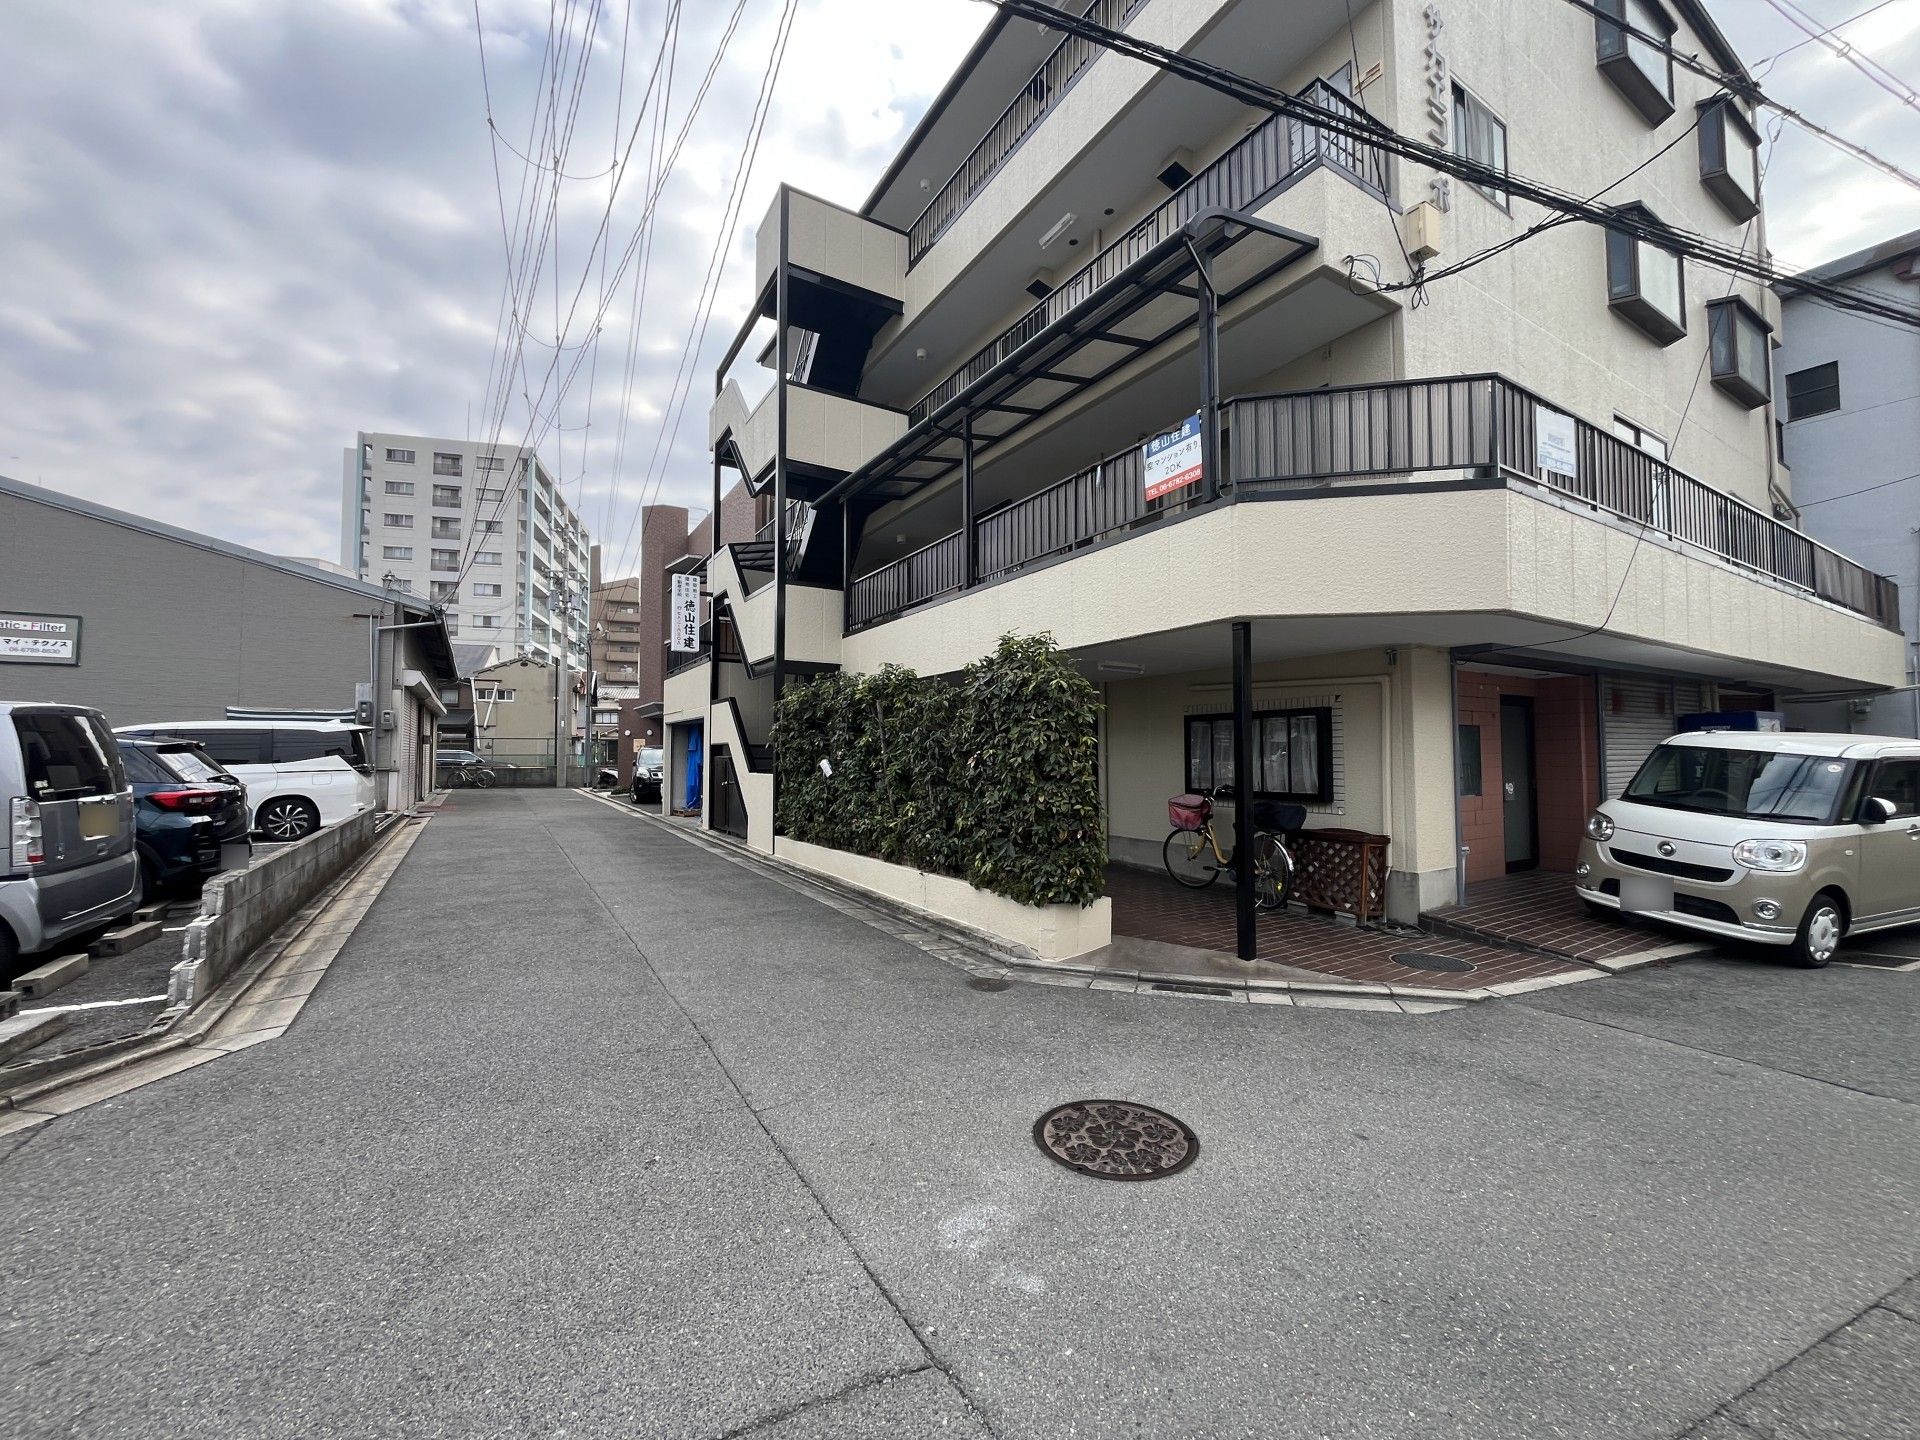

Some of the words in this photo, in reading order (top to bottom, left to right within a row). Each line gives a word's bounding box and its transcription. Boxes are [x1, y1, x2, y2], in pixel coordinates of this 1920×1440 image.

[1423, 4, 1450, 214] サカエコポ
[1151, 423, 1191, 452] 徳山住建
[1148, 488, 1159, 497] TEL
[683, 600, 697, 650] 徳山住建
[3, 638, 68, 647] マイ・テクノス
